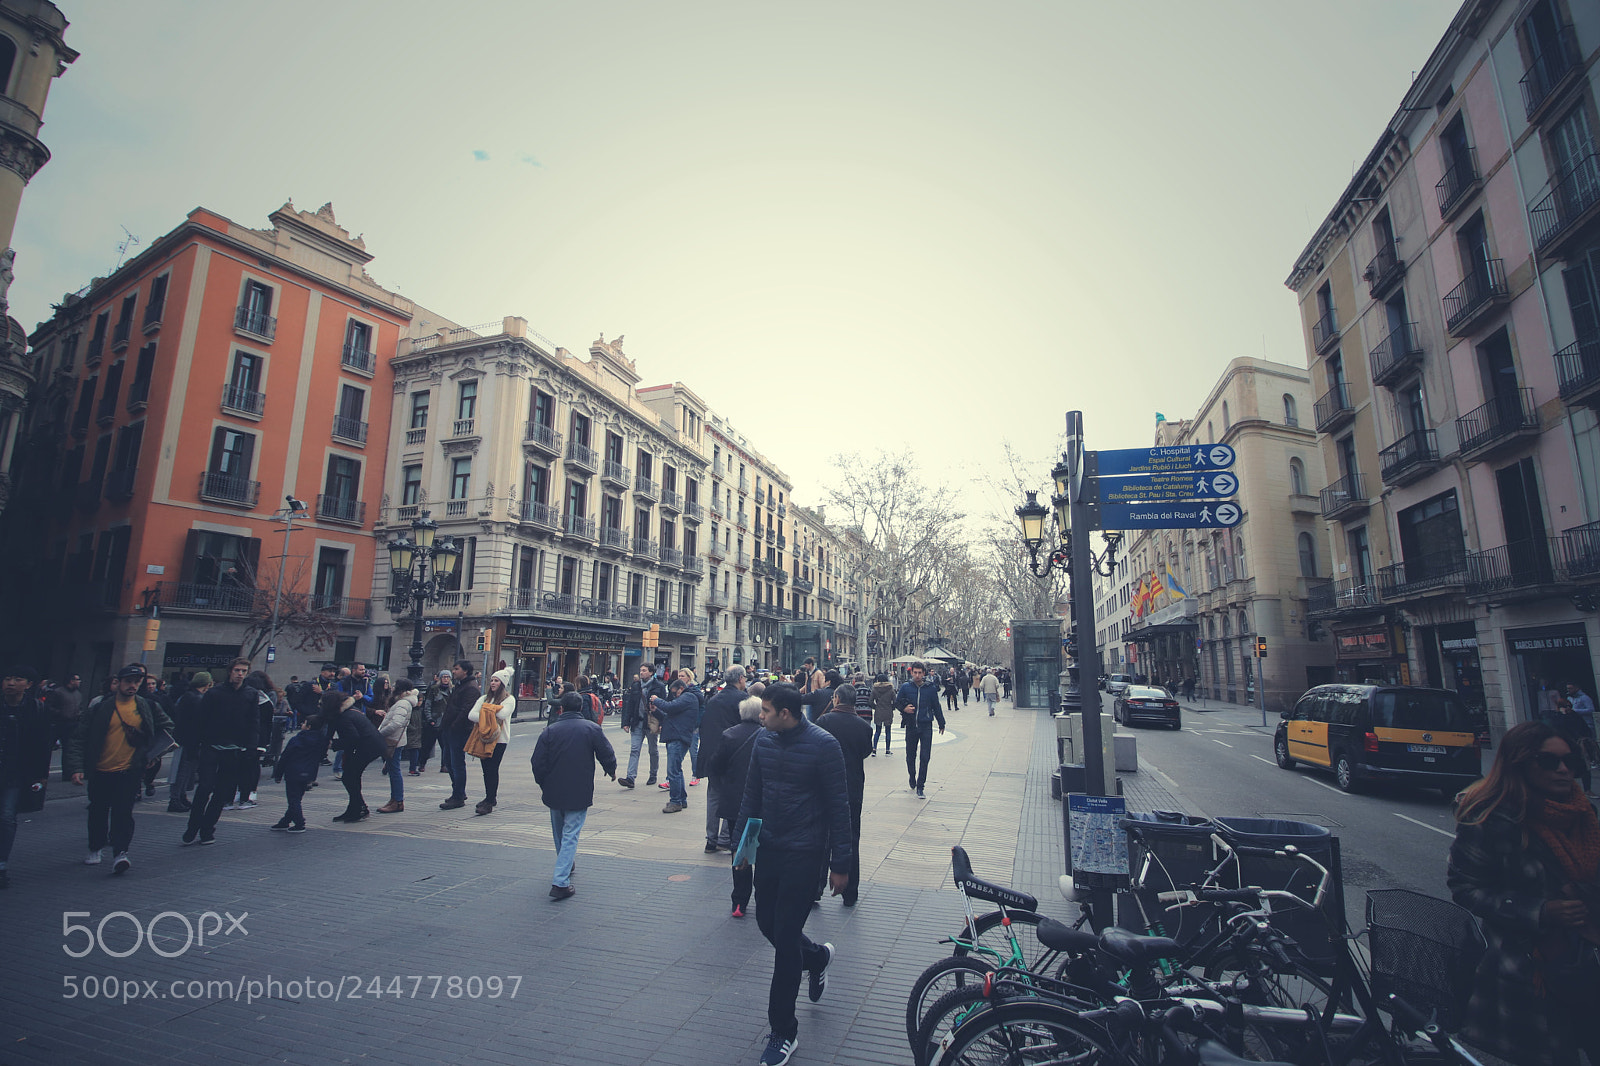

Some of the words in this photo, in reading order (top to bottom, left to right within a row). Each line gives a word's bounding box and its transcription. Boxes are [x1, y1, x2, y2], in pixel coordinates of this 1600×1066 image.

[1160, 447, 1191, 456] Hospital
[1163, 483, 1194, 491] Catalunya
[1130, 512, 1159, 520] Rambla
[1174, 511, 1197, 519] Raval
[1514, 639, 1545, 650] BARCELONA
[1546, 639, 1552, 648] IS
[1553, 638, 1563, 648] MY
[1564, 636, 1585, 647] STYLE
[966, 880, 994, 895] ORBEA
[998, 891, 1024, 905] FURIA
